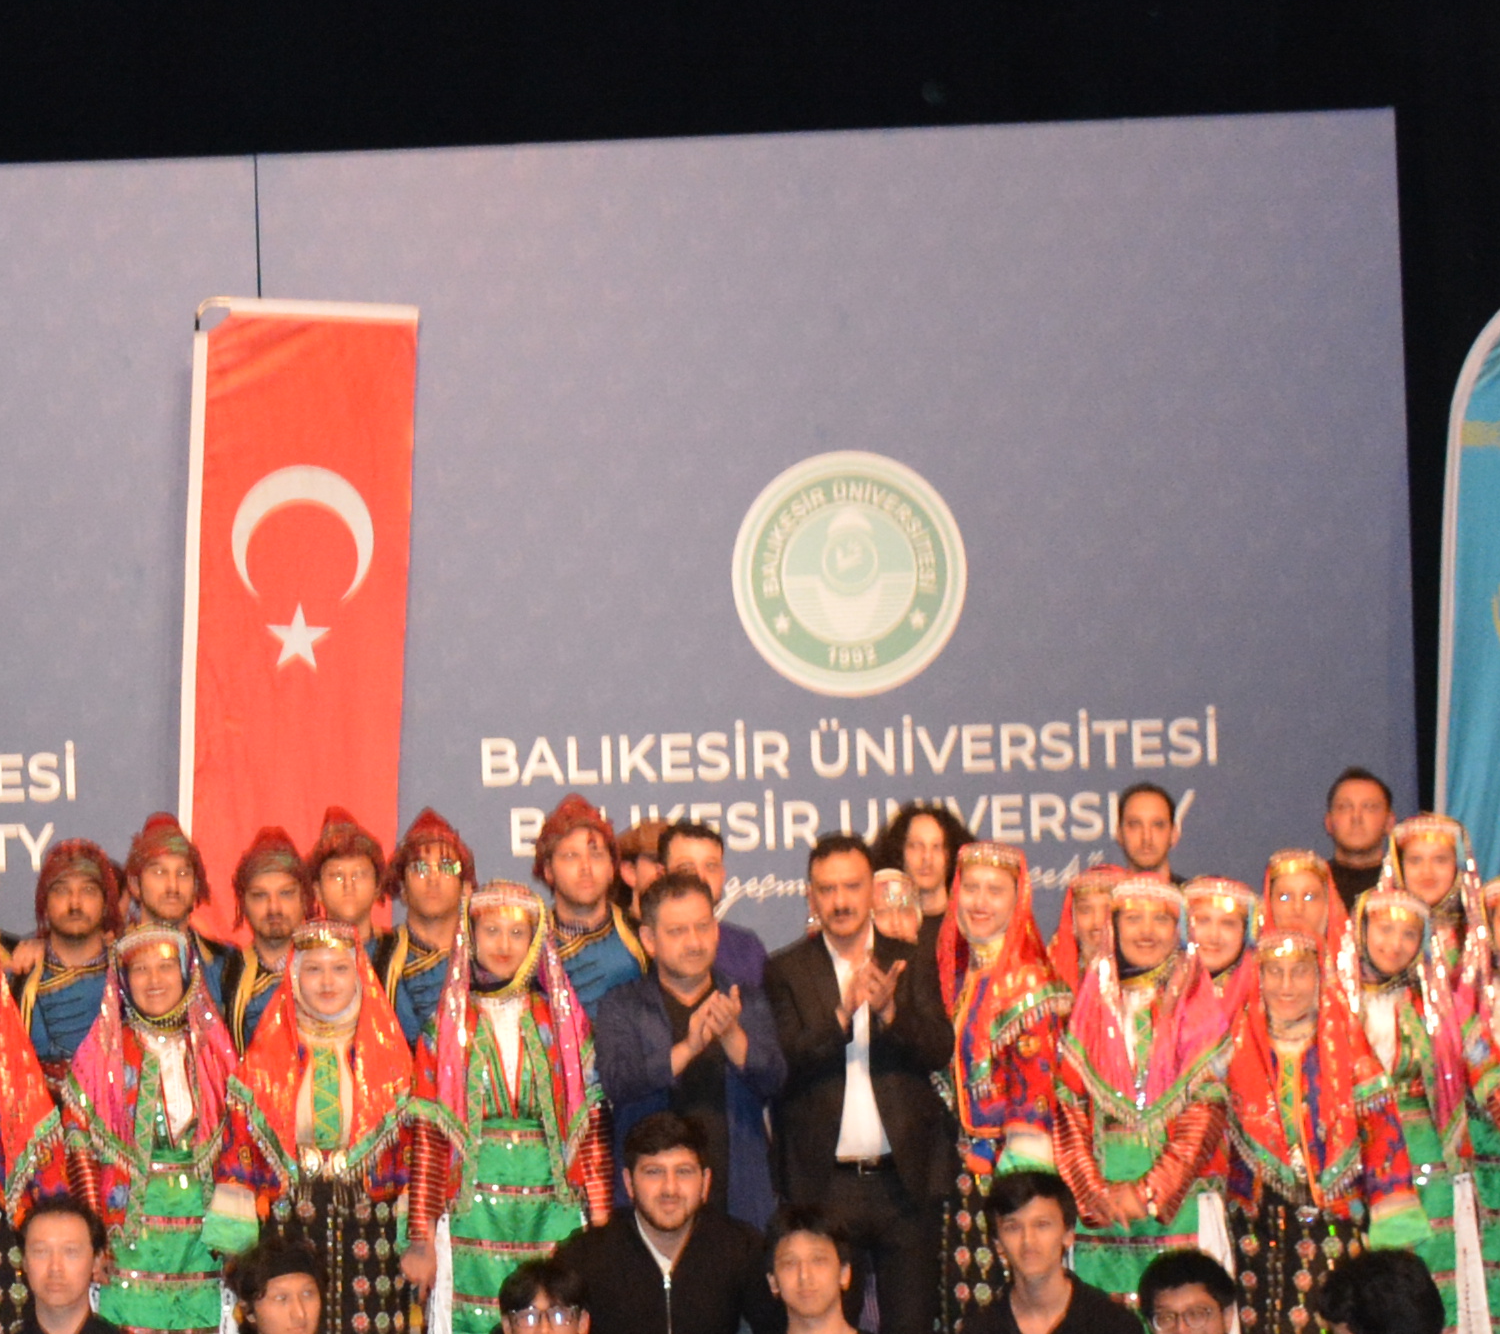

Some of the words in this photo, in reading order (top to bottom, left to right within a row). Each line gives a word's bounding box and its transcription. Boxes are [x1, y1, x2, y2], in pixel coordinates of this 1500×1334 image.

[762, 485, 827, 598] BALIKESİR
[480, 719, 790, 788] BALIKESİR
[810, 705, 1218, 779] ÜNİVERSİTESİ
[510, 789, 820, 857] BISİR
[840, 788, 1196, 846] UVERSIY
